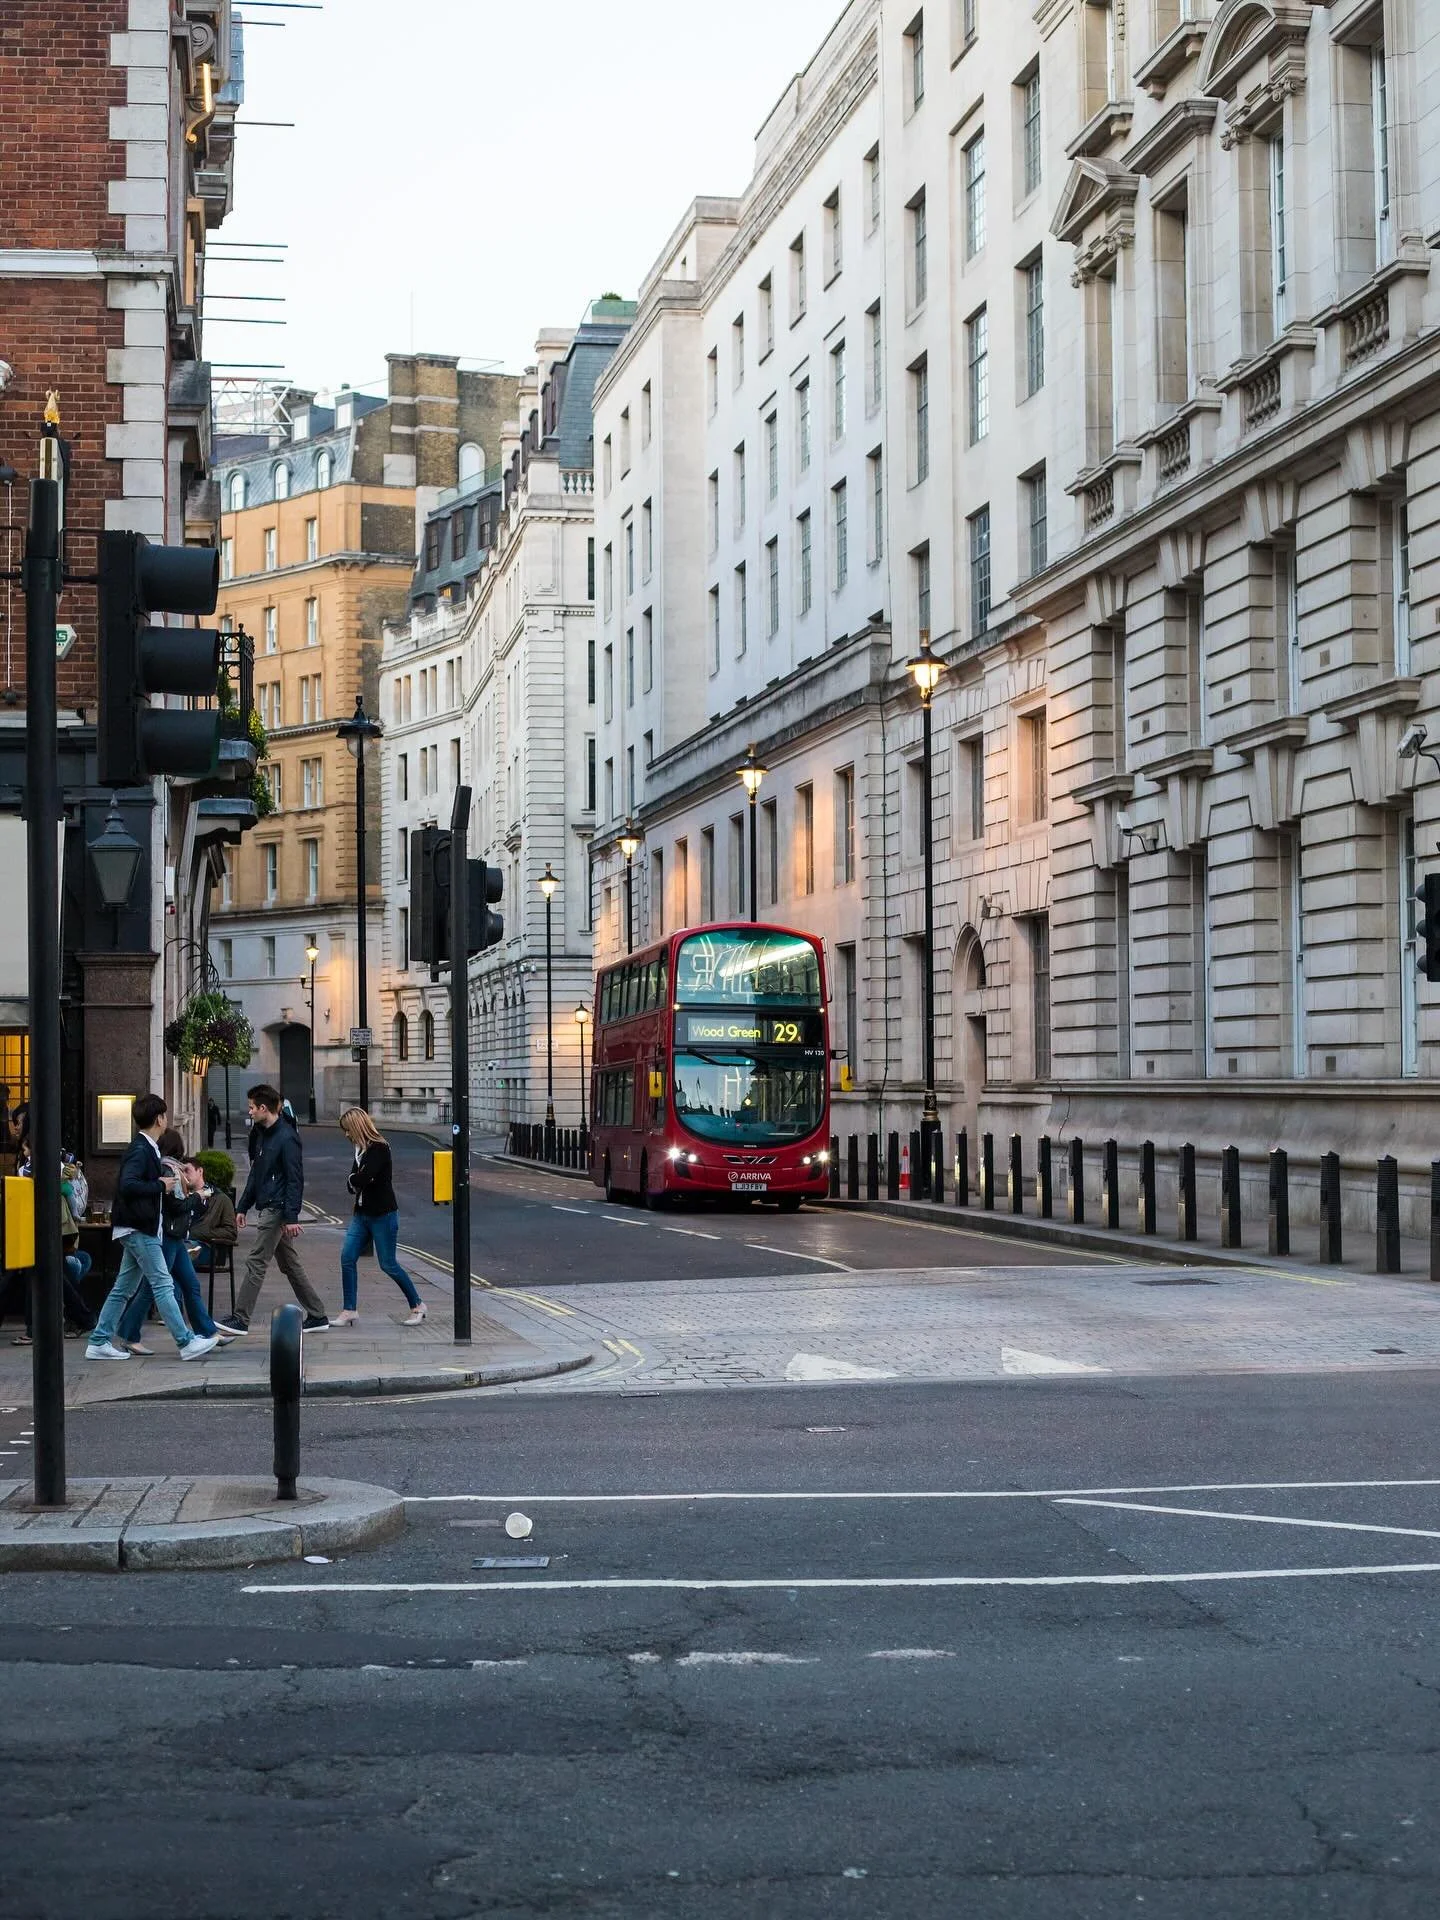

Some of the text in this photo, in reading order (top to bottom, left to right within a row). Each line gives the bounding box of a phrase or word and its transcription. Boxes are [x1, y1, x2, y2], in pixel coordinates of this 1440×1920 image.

[692, 1026, 761, 1038] Wood Green
[774, 1023, 798, 1042] 29
[740, 1172, 772, 1180] ARRIVA
